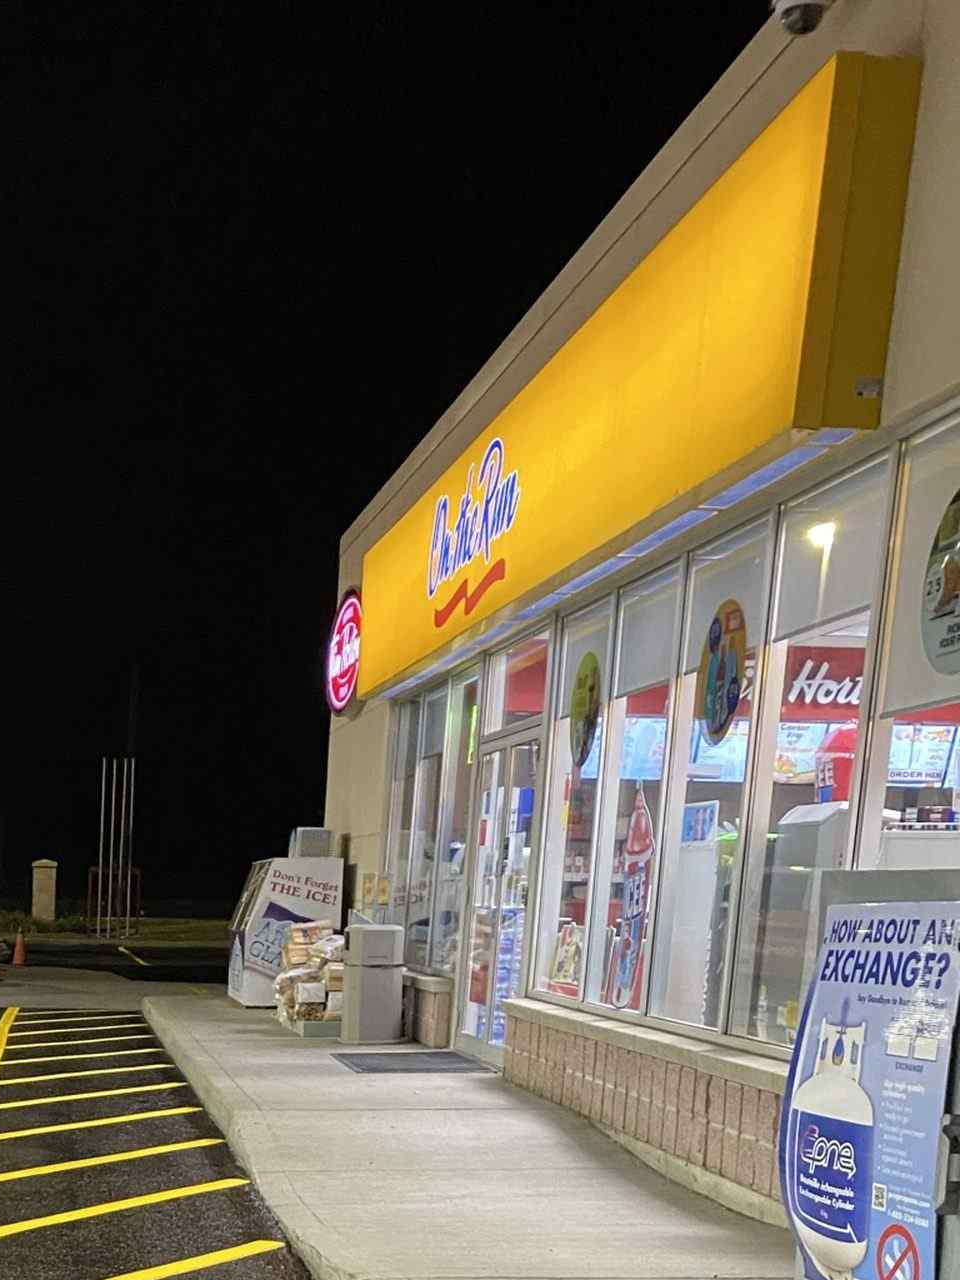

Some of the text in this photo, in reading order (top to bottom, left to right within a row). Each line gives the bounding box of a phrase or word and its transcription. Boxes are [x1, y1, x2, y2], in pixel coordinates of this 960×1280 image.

[427, 495, 456, 599] On
[477, 437, 521, 565] Run
[788, 659, 864, 705] Hort
[270, 881, 338, 906] THE ICE!
[272, 869, 339, 892] Don't Forget
[831, 919, 862, 943] HOW
[862, 919, 921, 944] ABOUT
[820, 949, 951, 989] EXCHANGE?
